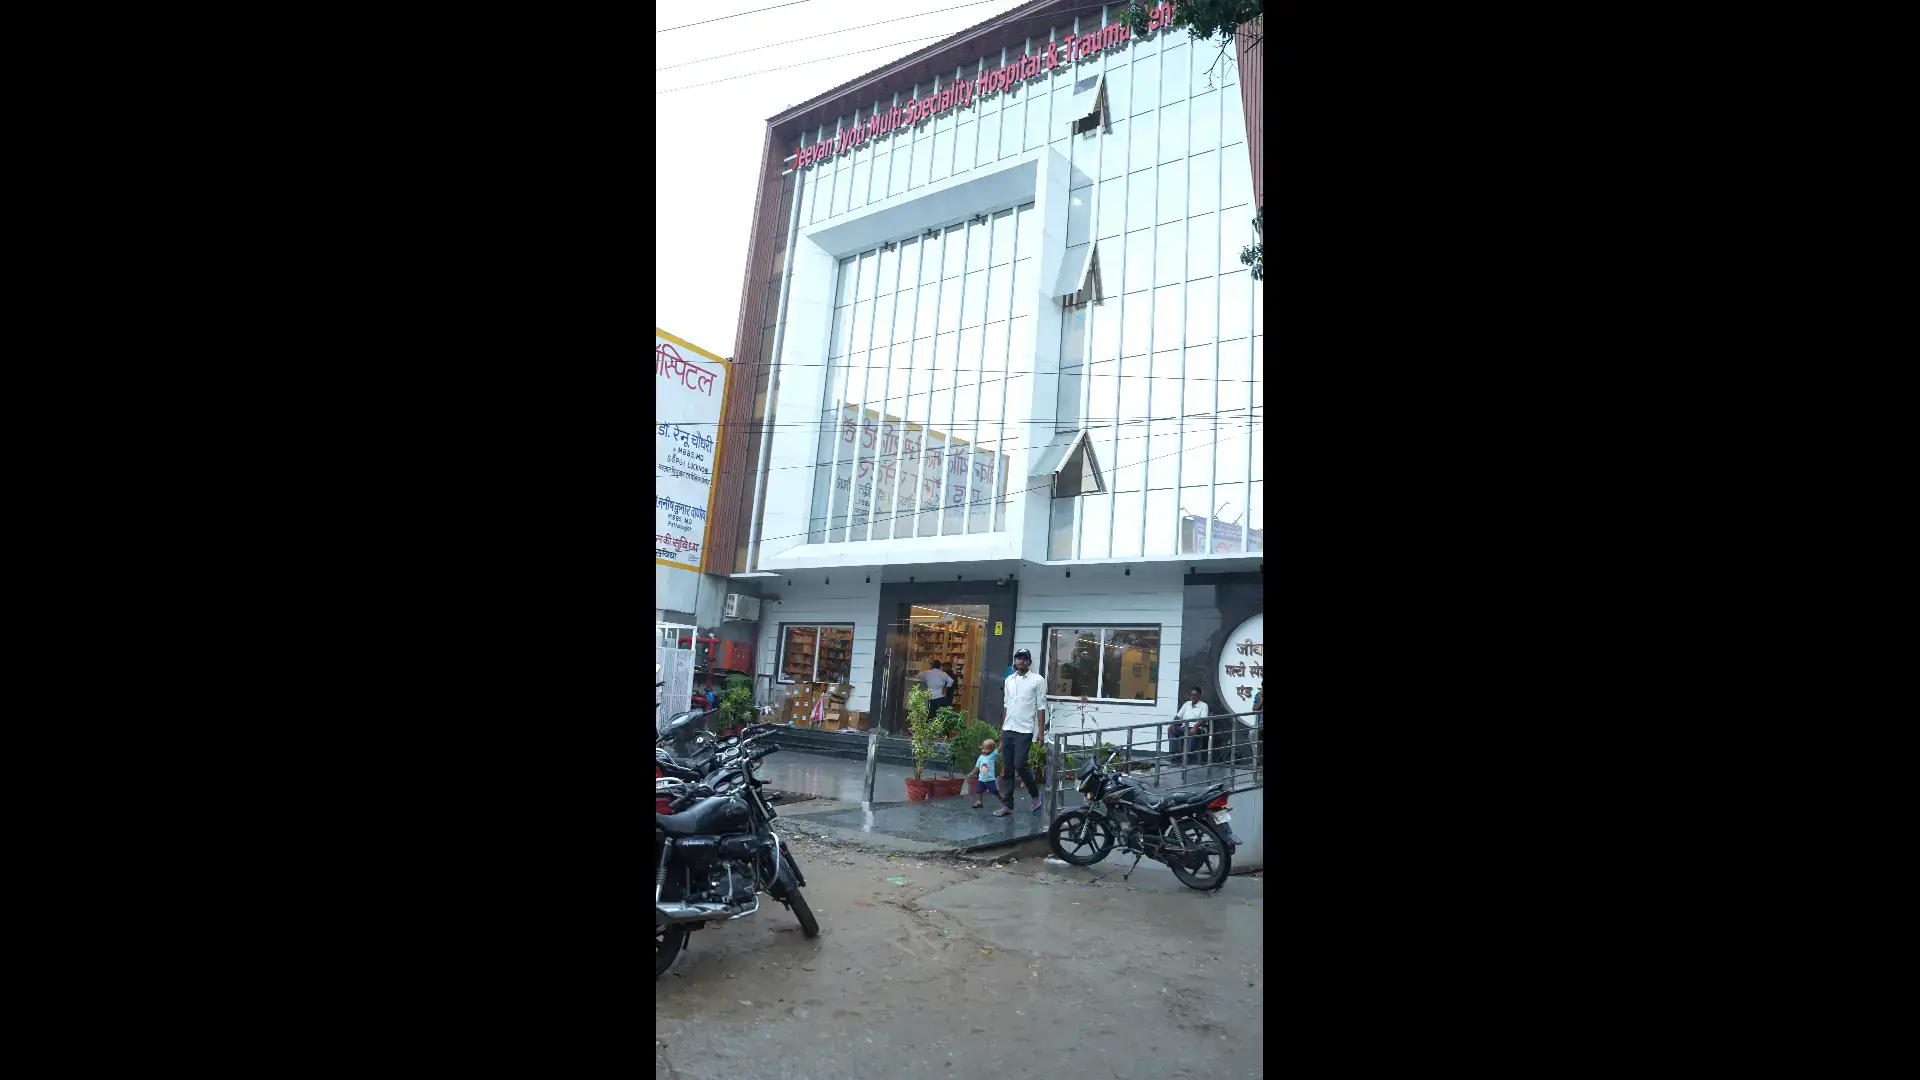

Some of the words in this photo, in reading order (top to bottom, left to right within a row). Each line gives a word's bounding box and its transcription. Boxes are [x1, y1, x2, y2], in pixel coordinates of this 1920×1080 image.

[792, 137, 833, 171] Jeevan
[834, 117, 867, 156] Jyoti
[868, 104, 904, 140] Multi
[904, 79, 975, 128] Speciality
[977, 45, 1043, 97] Hospital
[1045, 40, 1060, 70] &
[1063, 20, 1131, 63] Trauma
[674, 424, 691, 449] रेनू
